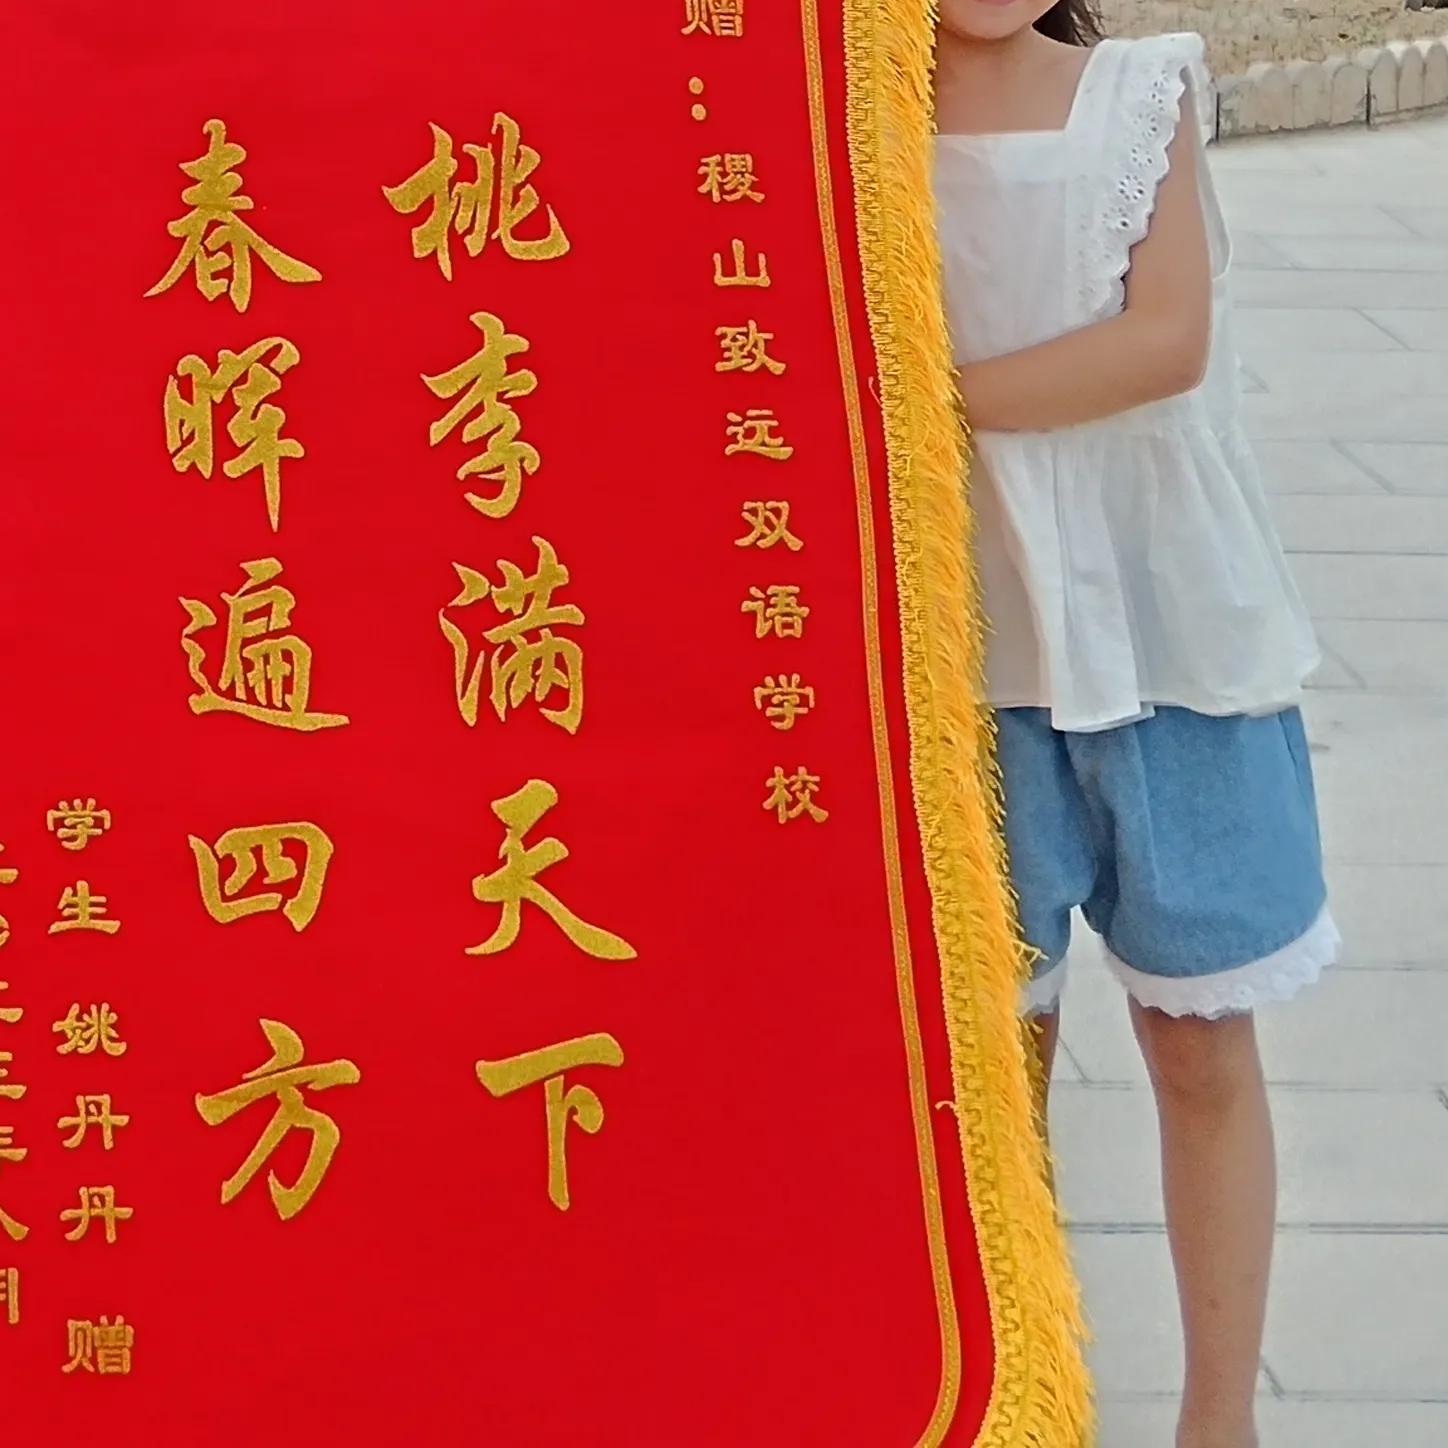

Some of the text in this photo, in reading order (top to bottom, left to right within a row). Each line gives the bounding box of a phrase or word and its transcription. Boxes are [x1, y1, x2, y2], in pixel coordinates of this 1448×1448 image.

[144, 117, 362, 1221] 春晖遍四方
[382, 111, 639, 1211] 桃李满天下
